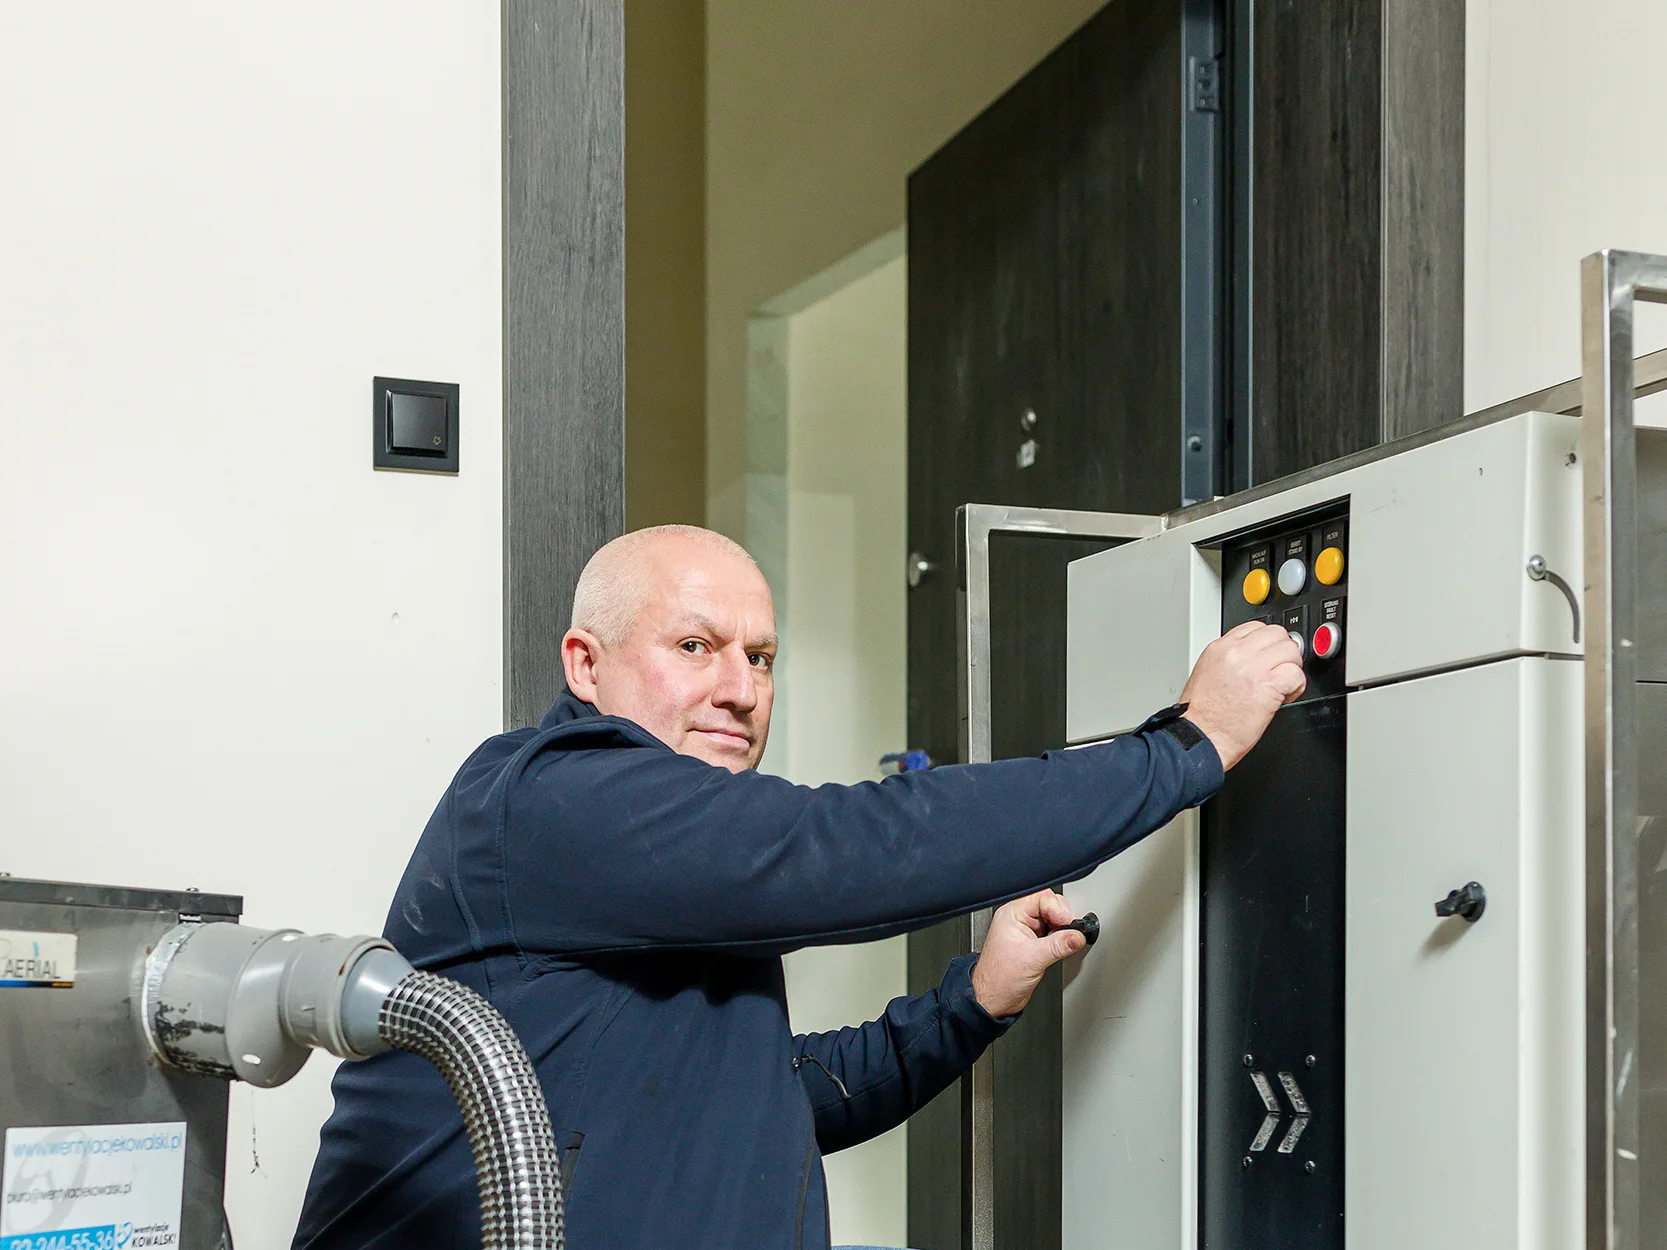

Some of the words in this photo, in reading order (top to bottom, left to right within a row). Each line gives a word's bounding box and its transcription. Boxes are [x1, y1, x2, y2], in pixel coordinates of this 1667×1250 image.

[3, 959, 61, 979] AERIAL
[12, 1132, 183, 1158] www.wentylacjekowalski.pl
[134, 1222, 169, 1235] wentylacje
[131, 1232, 178, 1248] KOWALSKI
